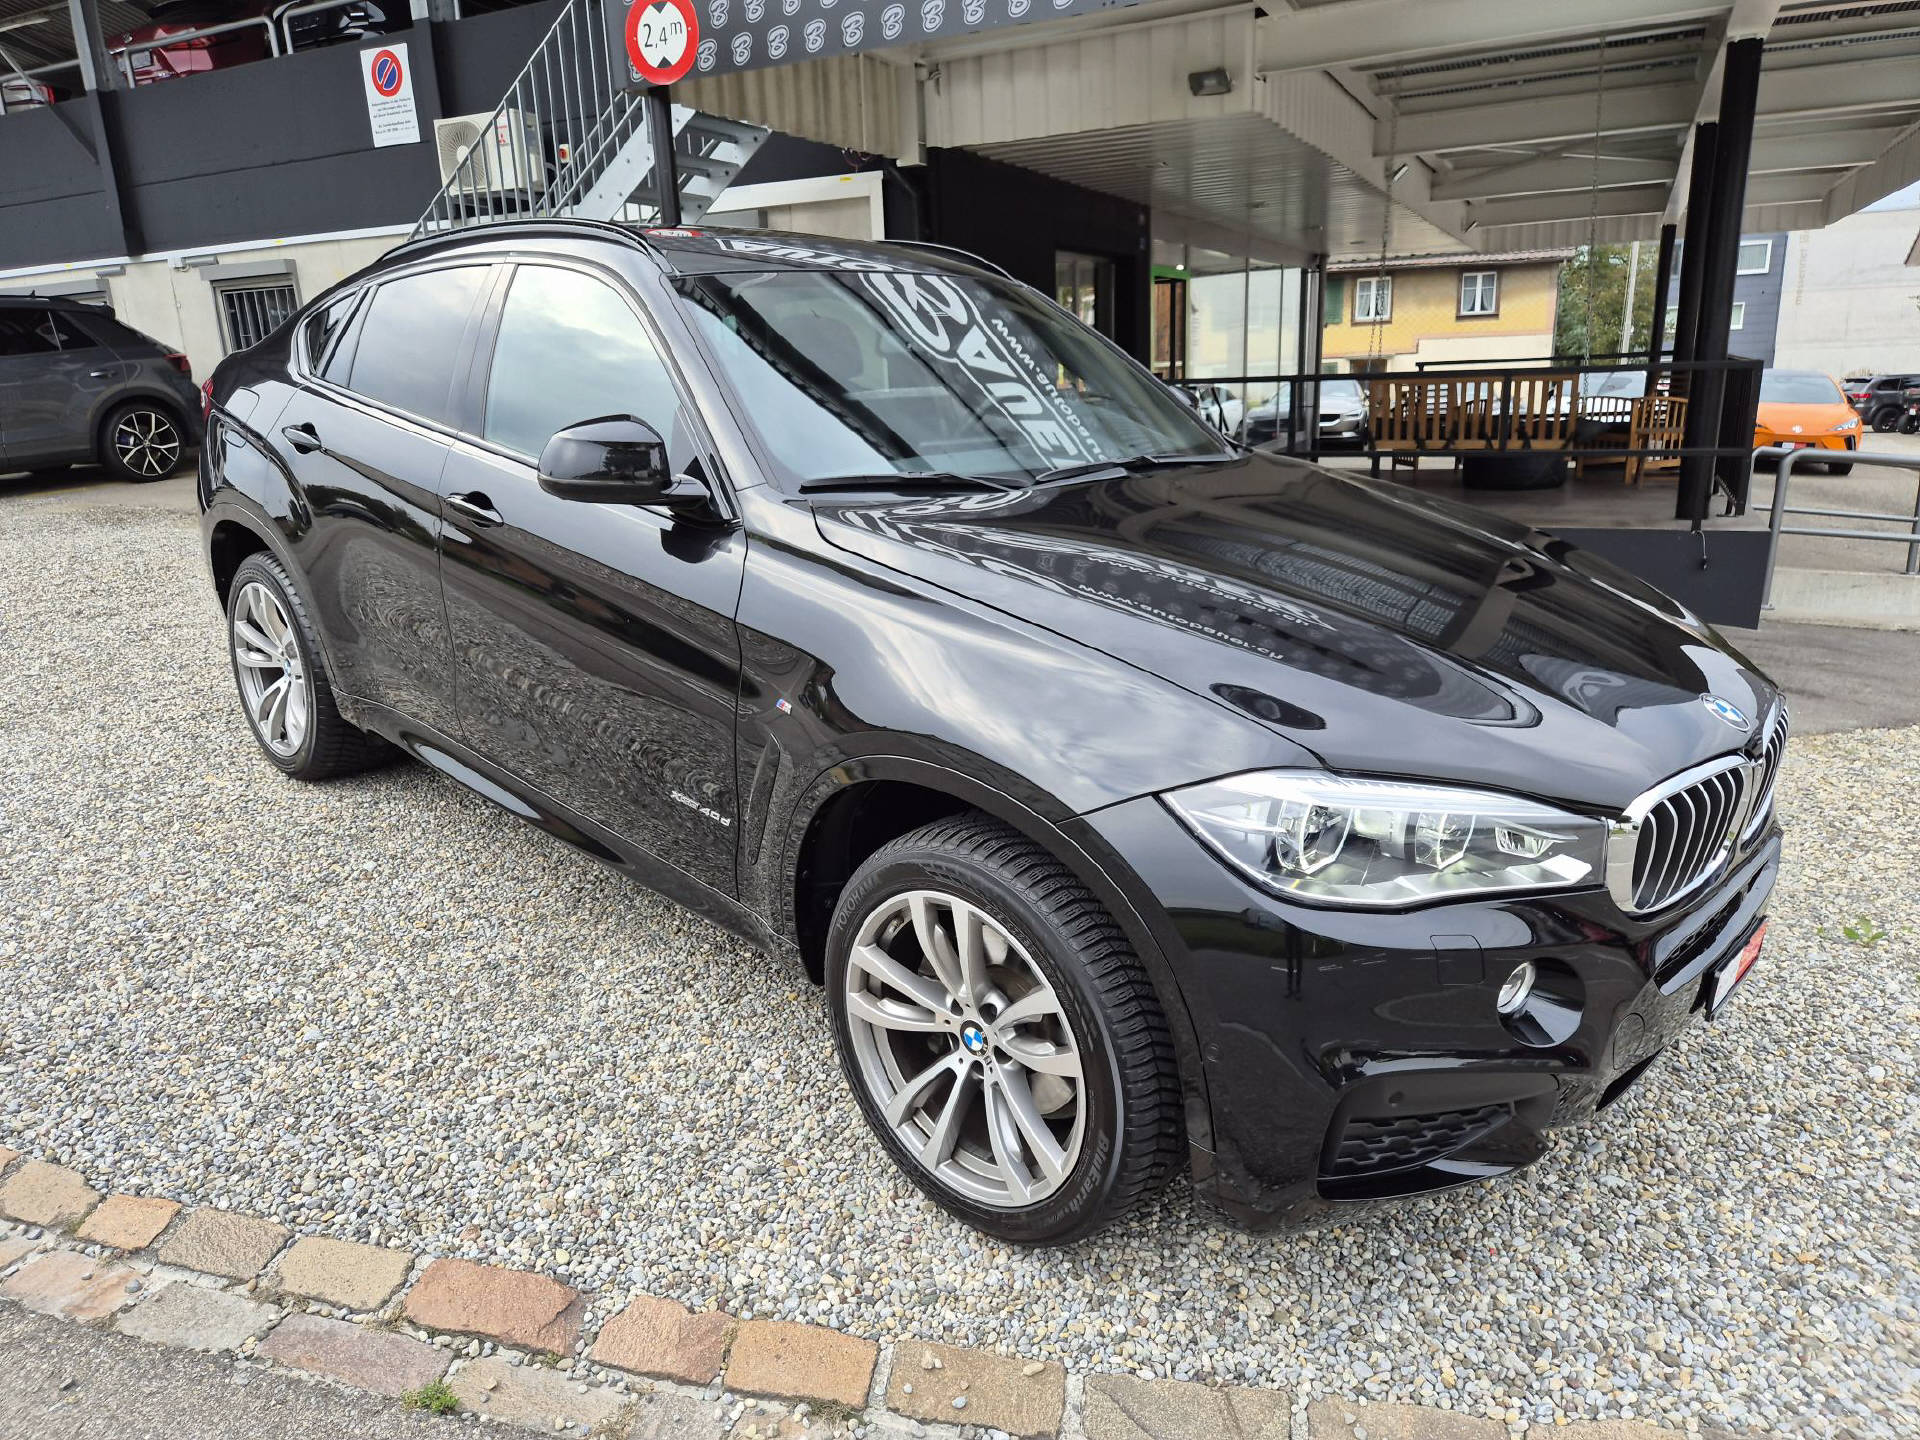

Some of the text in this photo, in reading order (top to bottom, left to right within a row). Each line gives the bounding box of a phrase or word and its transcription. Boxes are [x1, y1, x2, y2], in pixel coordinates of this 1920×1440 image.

[697, 39, 717, 71] B
[732, 32, 752, 65] B
[768, 25, 789, 59] B
[805, 19, 826, 52] B
[842, 11, 865, 46] B
[881, 4, 904, 39] B
[921, 0, 945, 31] B
[709, 0, 729, 28] B
